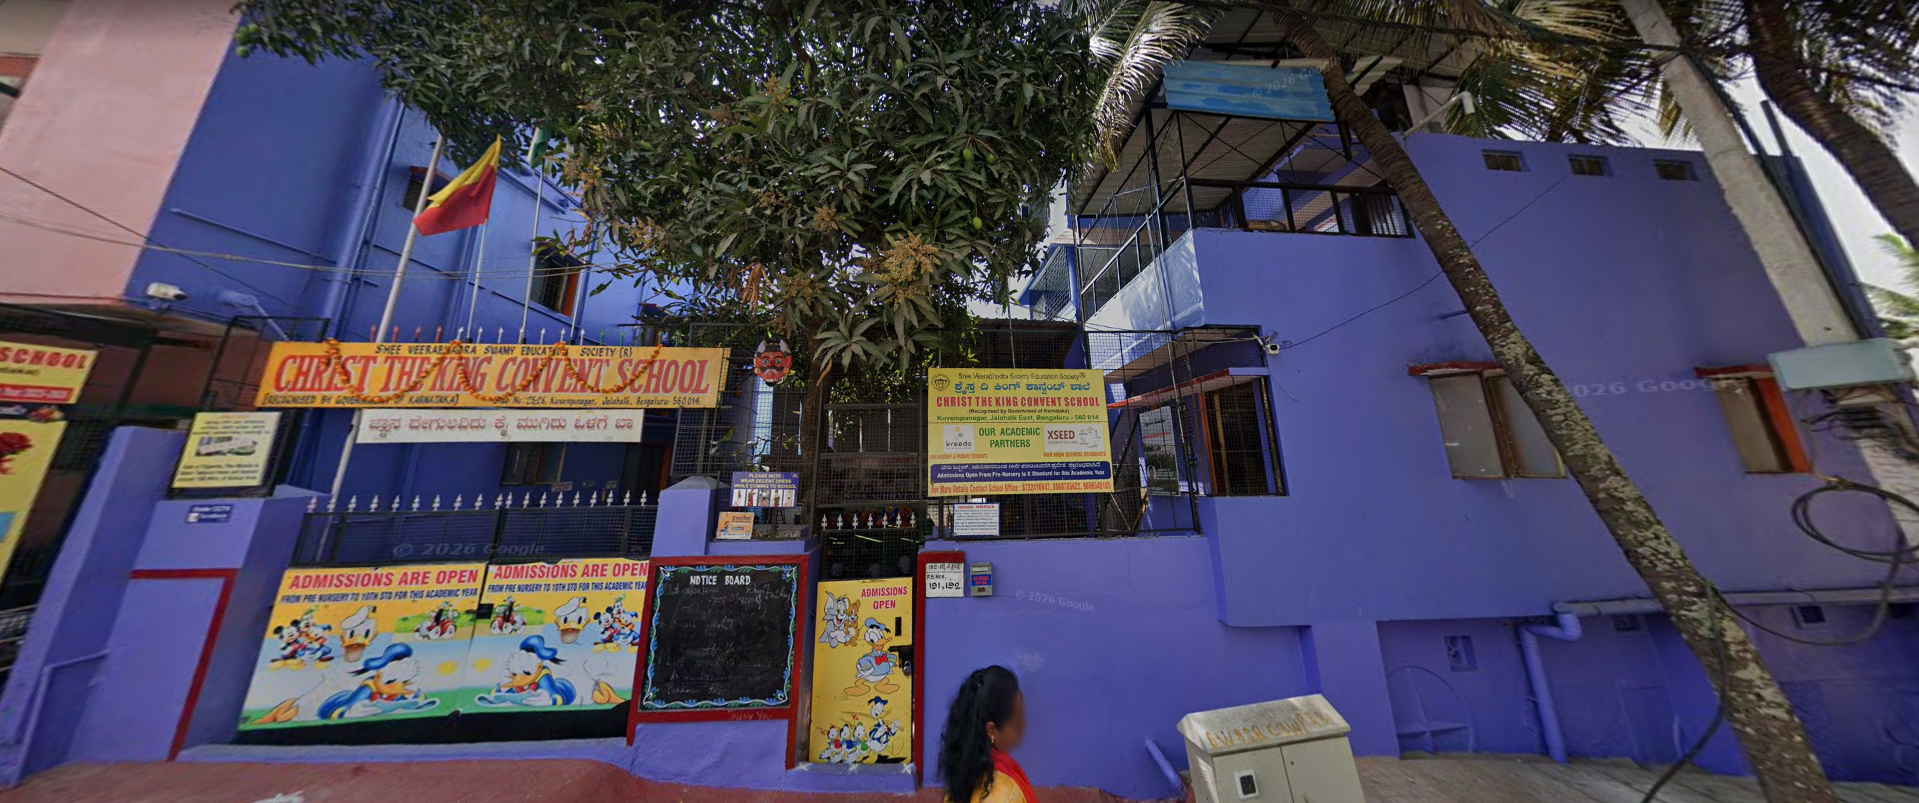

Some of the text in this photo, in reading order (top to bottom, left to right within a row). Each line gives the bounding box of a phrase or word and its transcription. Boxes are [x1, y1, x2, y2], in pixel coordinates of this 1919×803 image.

[484, 345, 515, 356] SWAMY
[580, 347, 616, 358] SOCIETY
[273, 355, 710, 394] CHRIST THE KING CONVENT SCHOOL
[980, 382, 989, 390] ದಿ
[994, 382, 1020, 390] ಕಿಂಗ್
[1070, 382, 1091, 390] ಶಾಲೆ
[936, 396, 1100, 407] CHRIST THE KING CONVENT SCHOOL
[615, 418, 634, 430] ಬಾ
[978, 427, 1040, 436] OUR ACADEMIC
[1047, 430, 1075, 440] XSEED
[990, 439, 1031, 448] PARTNERS
[952, 484, 969, 493] Details
[493, 562, 649, 580] ADMISSIONS ARE OPEN
[289, 570, 479, 590] ADMISSIONS ARE OPEN
[690, 575, 751, 585] NOTICE BOARD
[488, 584, 504, 593] FROM
[505, 584, 516, 592] PRE
[517, 584, 543, 592] NURSERY
[544, 583, 551, 592] TO
[552, 583, 567, 591] 10TH
[568, 583, 578, 591] STD
[579, 583, 591, 591] FOR
[592, 582, 604, 590] THIS
[605, 582, 633, 590] ACADEMIC
[861, 586, 908, 598] ADMISSIONS
[281, 595, 301, 604] FROM
[302, 594, 318, 603] PRE
[319, 594, 350, 602] NURSERY
[350, 593, 359, 602] TO
[361, 592, 378, 601] 10TH
[395, 591, 409, 599] FOR
[410, 590, 424, 599] THIS
[425, 589, 460, 598] ACADEMIC
[461, 588, 478, 596] YEAR
[873, 600, 896, 610] OPEN
